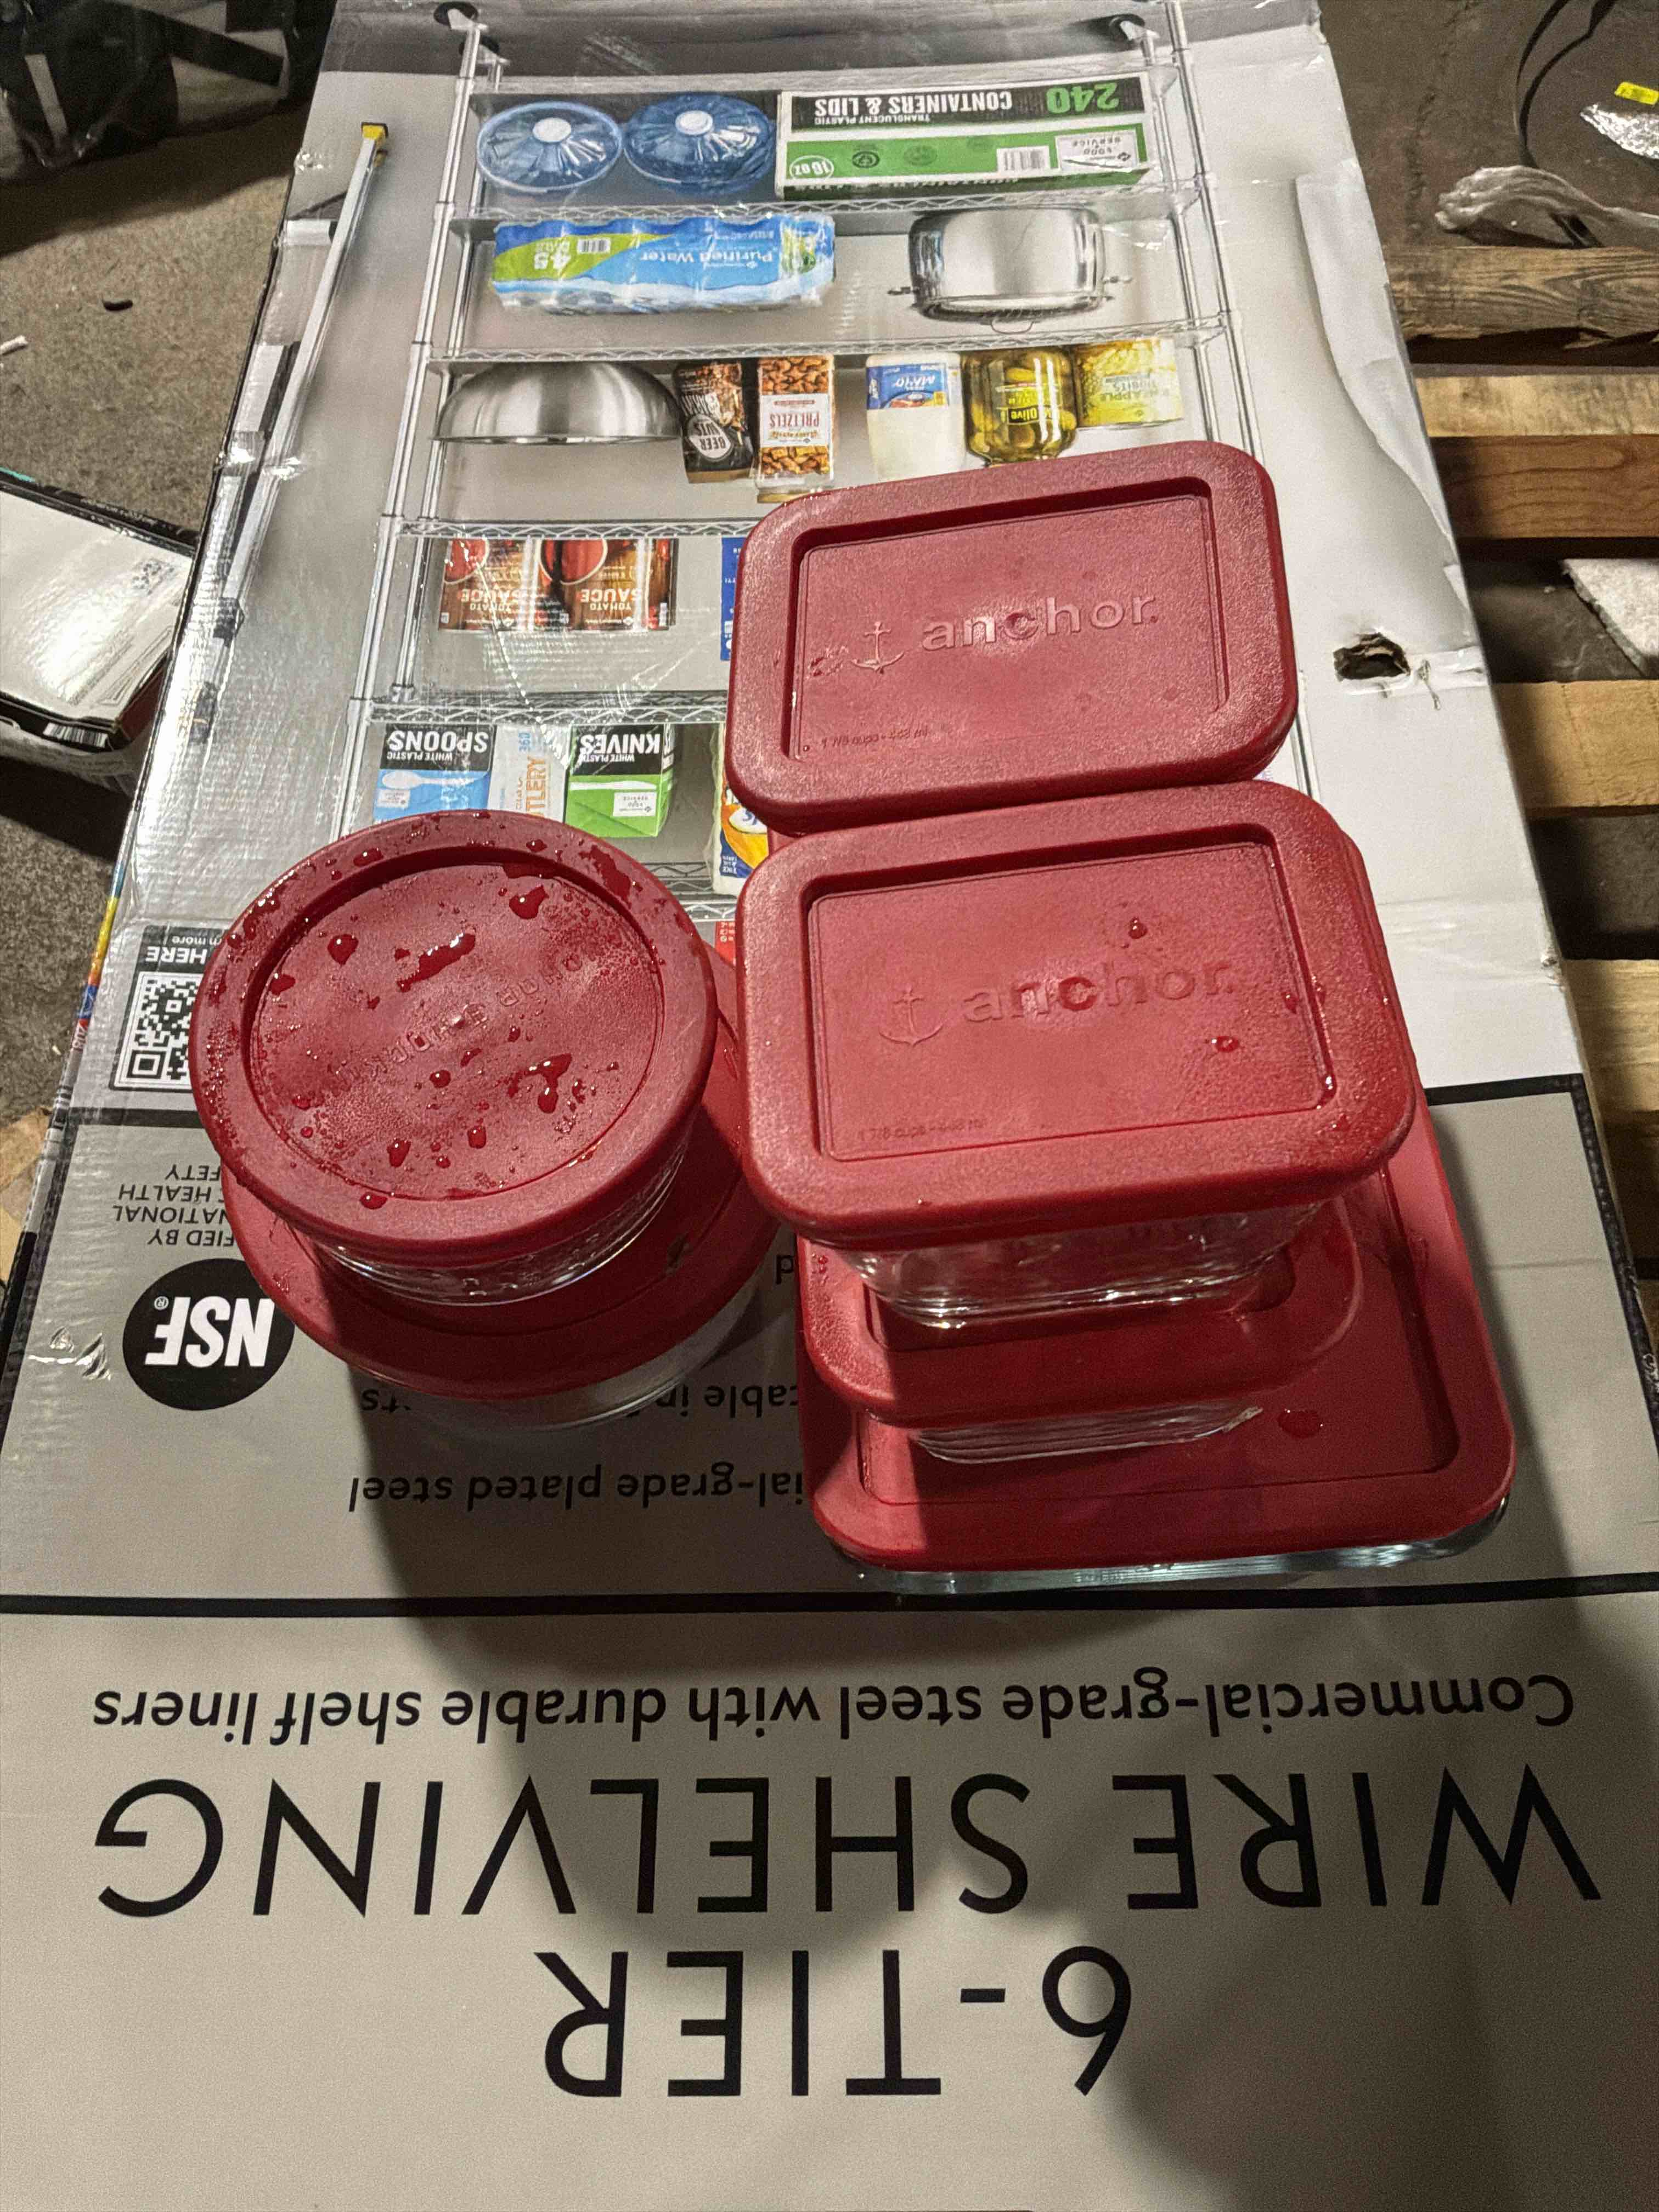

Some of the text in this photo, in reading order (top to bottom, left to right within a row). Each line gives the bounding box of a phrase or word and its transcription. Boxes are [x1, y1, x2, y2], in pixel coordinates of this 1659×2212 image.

[815, 91, 1013, 117] CONTAINERS & LIDS
[1045, 82, 1120, 114] 240
[814, 113, 930, 125] TRANSLUCENT PLASTIC
[640, 250, 773, 263] Purified Water
[769, 412, 820, 428] PRETZELS
[1011, 408, 1037, 421] Olive
[699, 437, 726, 450] BEER
[461, 589, 518, 602] SAUCE
[580, 589, 641, 602] SAUCE
[469, 602, 511, 611] TOMATO
[589, 602, 631, 611] TOMATO
[922, 596, 1156, 651] anchor
[388, 730, 488, 753] SPOONS
[579, 733, 661, 754] KNIVES
[386, 751, 453, 761] WHITE PLASTIC
[610, 754, 635, 763] WHITE
[526, 755, 545, 817] TLERY
[172, 936, 206, 946] more
[145, 946, 208, 964] HERE
[964, 962, 1231, 1023] anchor
[165, 1164, 221, 1181] FETY
[118, 1184, 212, 1203] HEALTH
[112, 1205, 227, 1224] NATIONAL
[148, 1229, 179, 1245] BY
[348, 1462, 803, 1513] ial-grade plated steel
[93, 1667, 1574, 1747] Commercial-grade steel with durable shelf liners
[94, 1764, 1602, 1918] WIRE SHELVING
[534, 1945, 1132, 2098] 6-TIER
